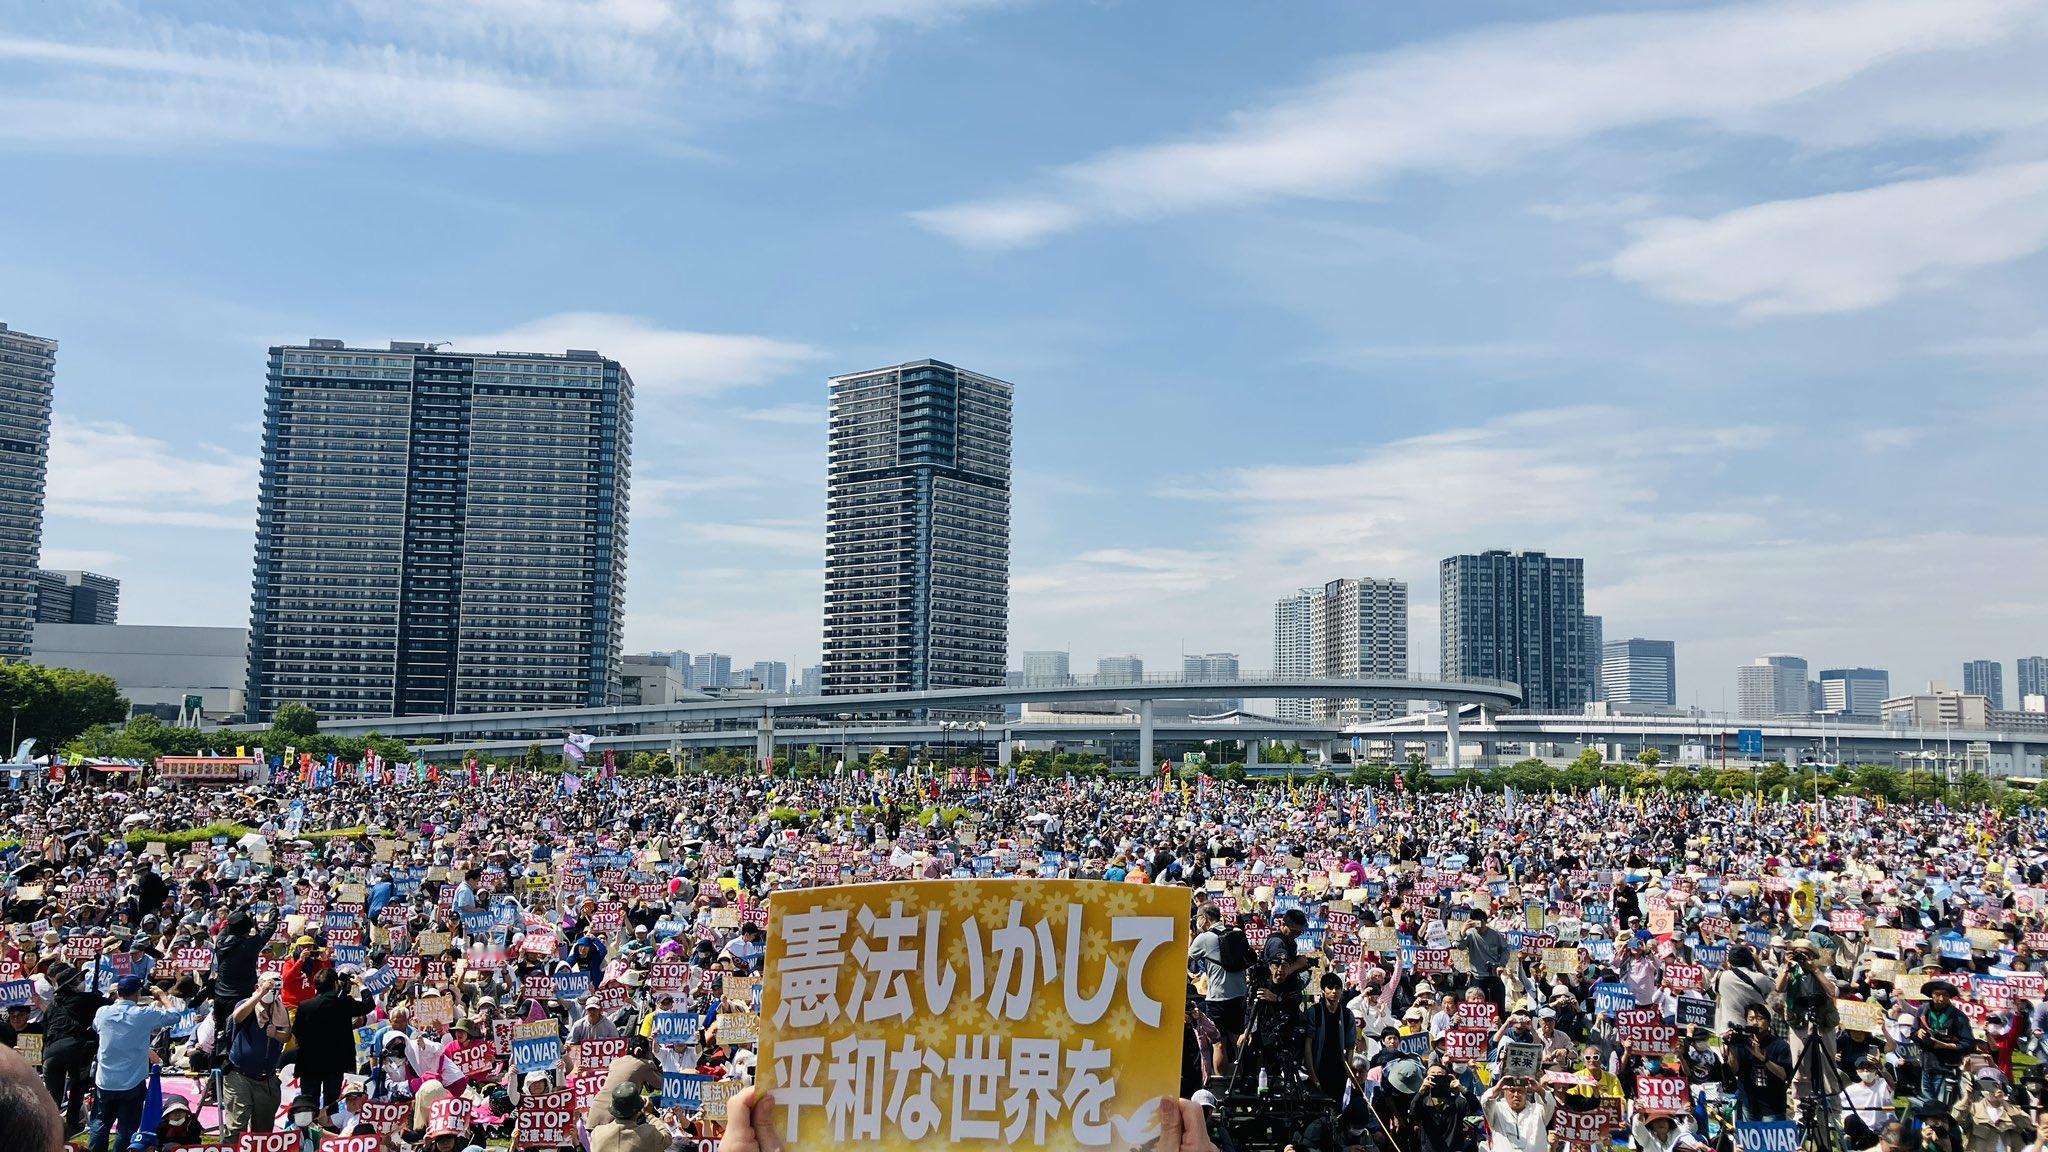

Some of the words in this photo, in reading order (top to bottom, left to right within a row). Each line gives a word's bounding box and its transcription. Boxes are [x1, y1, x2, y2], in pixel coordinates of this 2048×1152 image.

[325, 915, 337, 927] NO
[338, 915, 353, 927] WAR
[465, 915, 476, 928] NO
[477, 915, 494, 928] WAR
[1329, 913, 1355, 923] STOP
[328, 929, 358, 939] STOP
[1508, 935, 1519, 946] NO
[1523, 935, 1552, 946] STOP
[1746, 931, 1756, 943] NO
[1757, 933, 1770, 943] WAR
[68, 938, 99, 948] STOP
[1584, 942, 1595, 954] NO
[1597, 942, 1611, 954] WAR
[1939, 939, 1951, 951] NO
[1954, 939, 1970, 951] WAR
[335, 950, 347, 961] NO
[349, 950, 365, 962] WAR
[388, 957, 420, 968] STOP
[1696, 951, 1706, 962] NO
[1709, 951, 1725, 962] WAR
[653, 965, 688, 976] STOP
[772, 900, 1175, 1029] 憲法いかして
[1666, 965, 1700, 978] STOP
[556, 976, 567, 989] NO
[570, 976, 589, 989] WAR
[9, 984, 32, 998] WAR
[595, 988, 625, 1000] STOP
[1598, 995, 1611, 1010] NO
[1612, 996, 1634, 1010] WAR
[1459, 1004, 1495, 1016] STOP
[1618, 1011, 1655, 1024] STOP
[657, 1018, 671, 1035] NO
[674, 1018, 696, 1035] WAR
[1632, 1027, 1675, 1040] STOP
[1408, 1037, 1428, 1052] WAR
[1447, 1033, 1485, 1047] STOP
[453, 1044, 487, 1064] STOP
[514, 1046, 531, 1064] NO
[532, 1042, 558, 1062] WAR
[582, 1040, 625, 1056] STOP
[575, 1076, 608, 1093] STO
[663, 1078, 680, 1098] NO
[684, 1078, 700, 1098] WA
[772, 1033, 1116, 1146] 平和な世界を
[1639, 1079, 1685, 1094] STOP
[431, 1099, 470, 1116] STOP
[523, 1093, 572, 1108] STOP
[362, 1103, 409, 1119] STOP
[520, 1111, 570, 1128] STOP
[1556, 1111, 1606, 1129] STOP
[240, 1134, 298, 1152] STOP
[322, 1138, 378, 1152] STOP
[1739, 1130, 1761, 1151] NO
[1765, 1130, 1797, 1151] WAR
